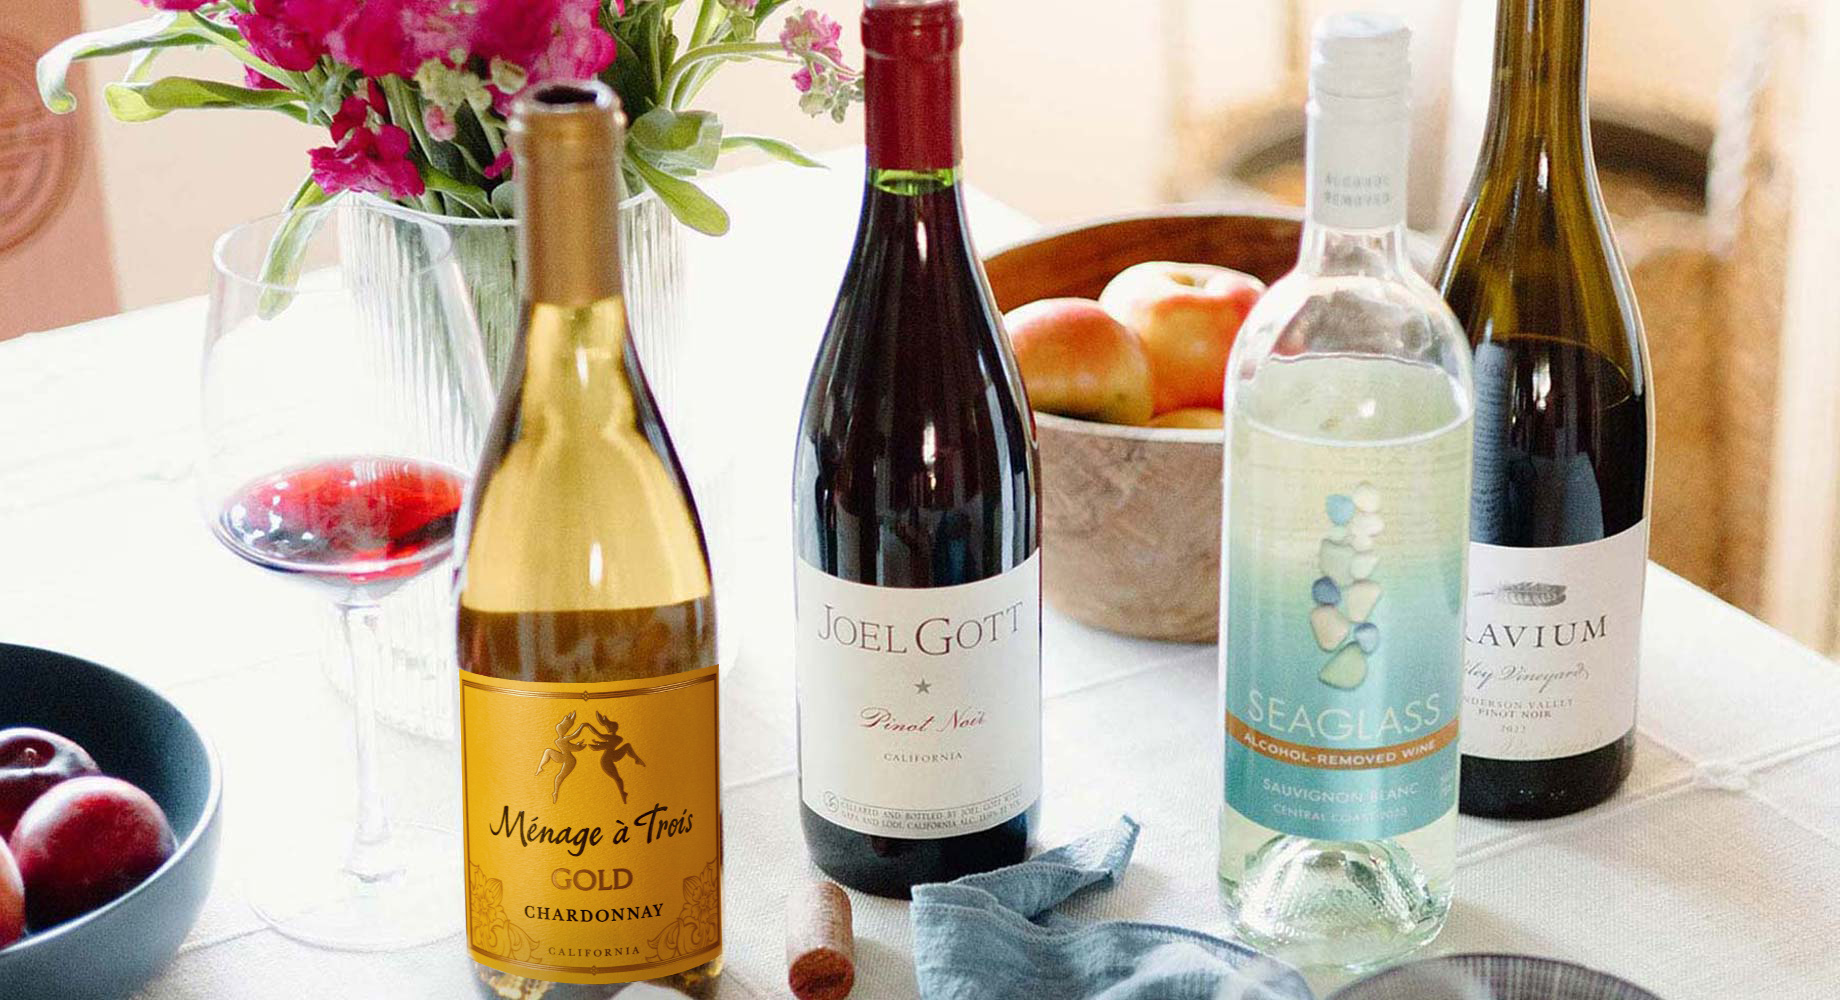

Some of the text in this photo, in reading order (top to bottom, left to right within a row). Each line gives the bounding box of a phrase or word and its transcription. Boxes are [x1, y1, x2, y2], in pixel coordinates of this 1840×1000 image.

[817, 601, 1024, 657] JOEL GOTT
[1497, 662, 1590, 694] Vineyard
[1478, 708, 1552, 719] PINOT NOIR
[1528, 698, 1574, 710] VALLEY
[858, 706, 934, 733] Pinot
[1248, 690, 1441, 742] SEAGLASS
[883, 752, 963, 764] CALIFORNIA
[1244, 732, 1396, 767] ALCOHOL-REMOVED
[1401, 741, 1437, 759] WINE
[1263, 778, 1364, 804] SAUVIGNON
[1369, 782, 1420, 803] BLANC
[904, 812, 943, 820] BOTTLED
[1272, 804, 1326, 822] CENTRAL
[489, 802, 694, 858] Ménage à Trois
[906, 821, 957, 830] CALIFORNIA
[551, 867, 633, 892] GOLD
[524, 902, 664, 923] CHARDONNAY
[548, 945, 641, 959] CALIFORNIA
